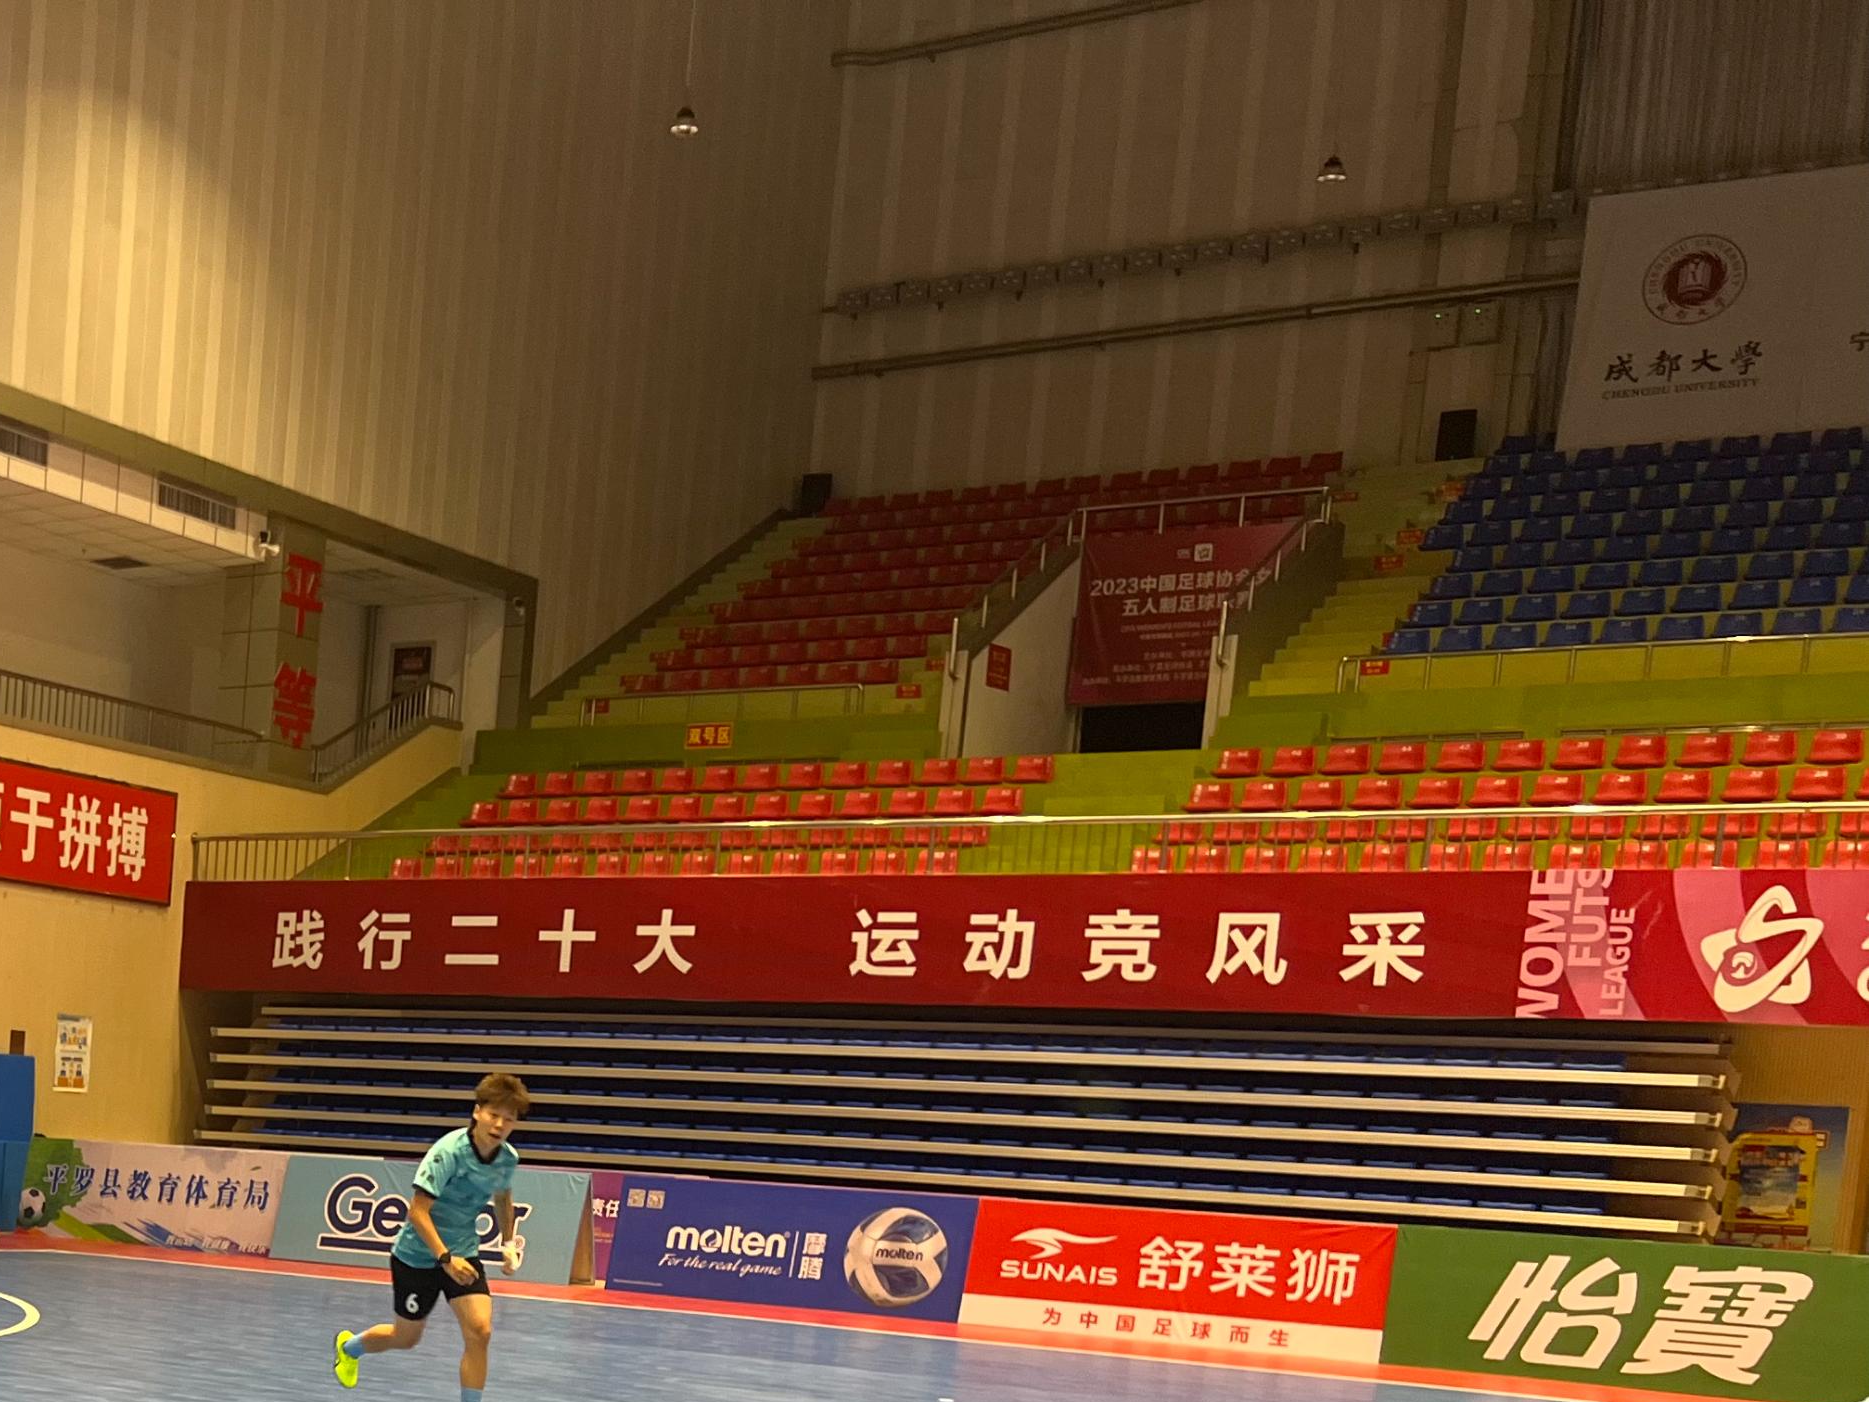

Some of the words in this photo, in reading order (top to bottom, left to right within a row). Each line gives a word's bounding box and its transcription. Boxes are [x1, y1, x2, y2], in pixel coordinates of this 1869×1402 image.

[273, 551, 325, 750] 平等
[688, 725, 731, 745] 双号区
[271, 907, 697, 975] 践行二十大
[848, 907, 1427, 987] 运动竞风采
[1599, 907, 1636, 1018] LEAGUE
[42, 1162, 271, 1213] 平罗县教育体育局
[665, 1225, 788, 1259] molten
[875, 1247, 924, 1262] molten
[658, 1252, 683, 1267] For
[683, 1255, 707, 1270] the
[708, 1258, 742, 1271] real
[738, 1263, 783, 1278] game
[999, 1258, 1118, 1287] SUNAIS
[1136, 1235, 1360, 1307] 舒莱狮
[405, 1292, 420, 1314] 6
[1041, 1306, 1290, 1348] 为中国足球而生
